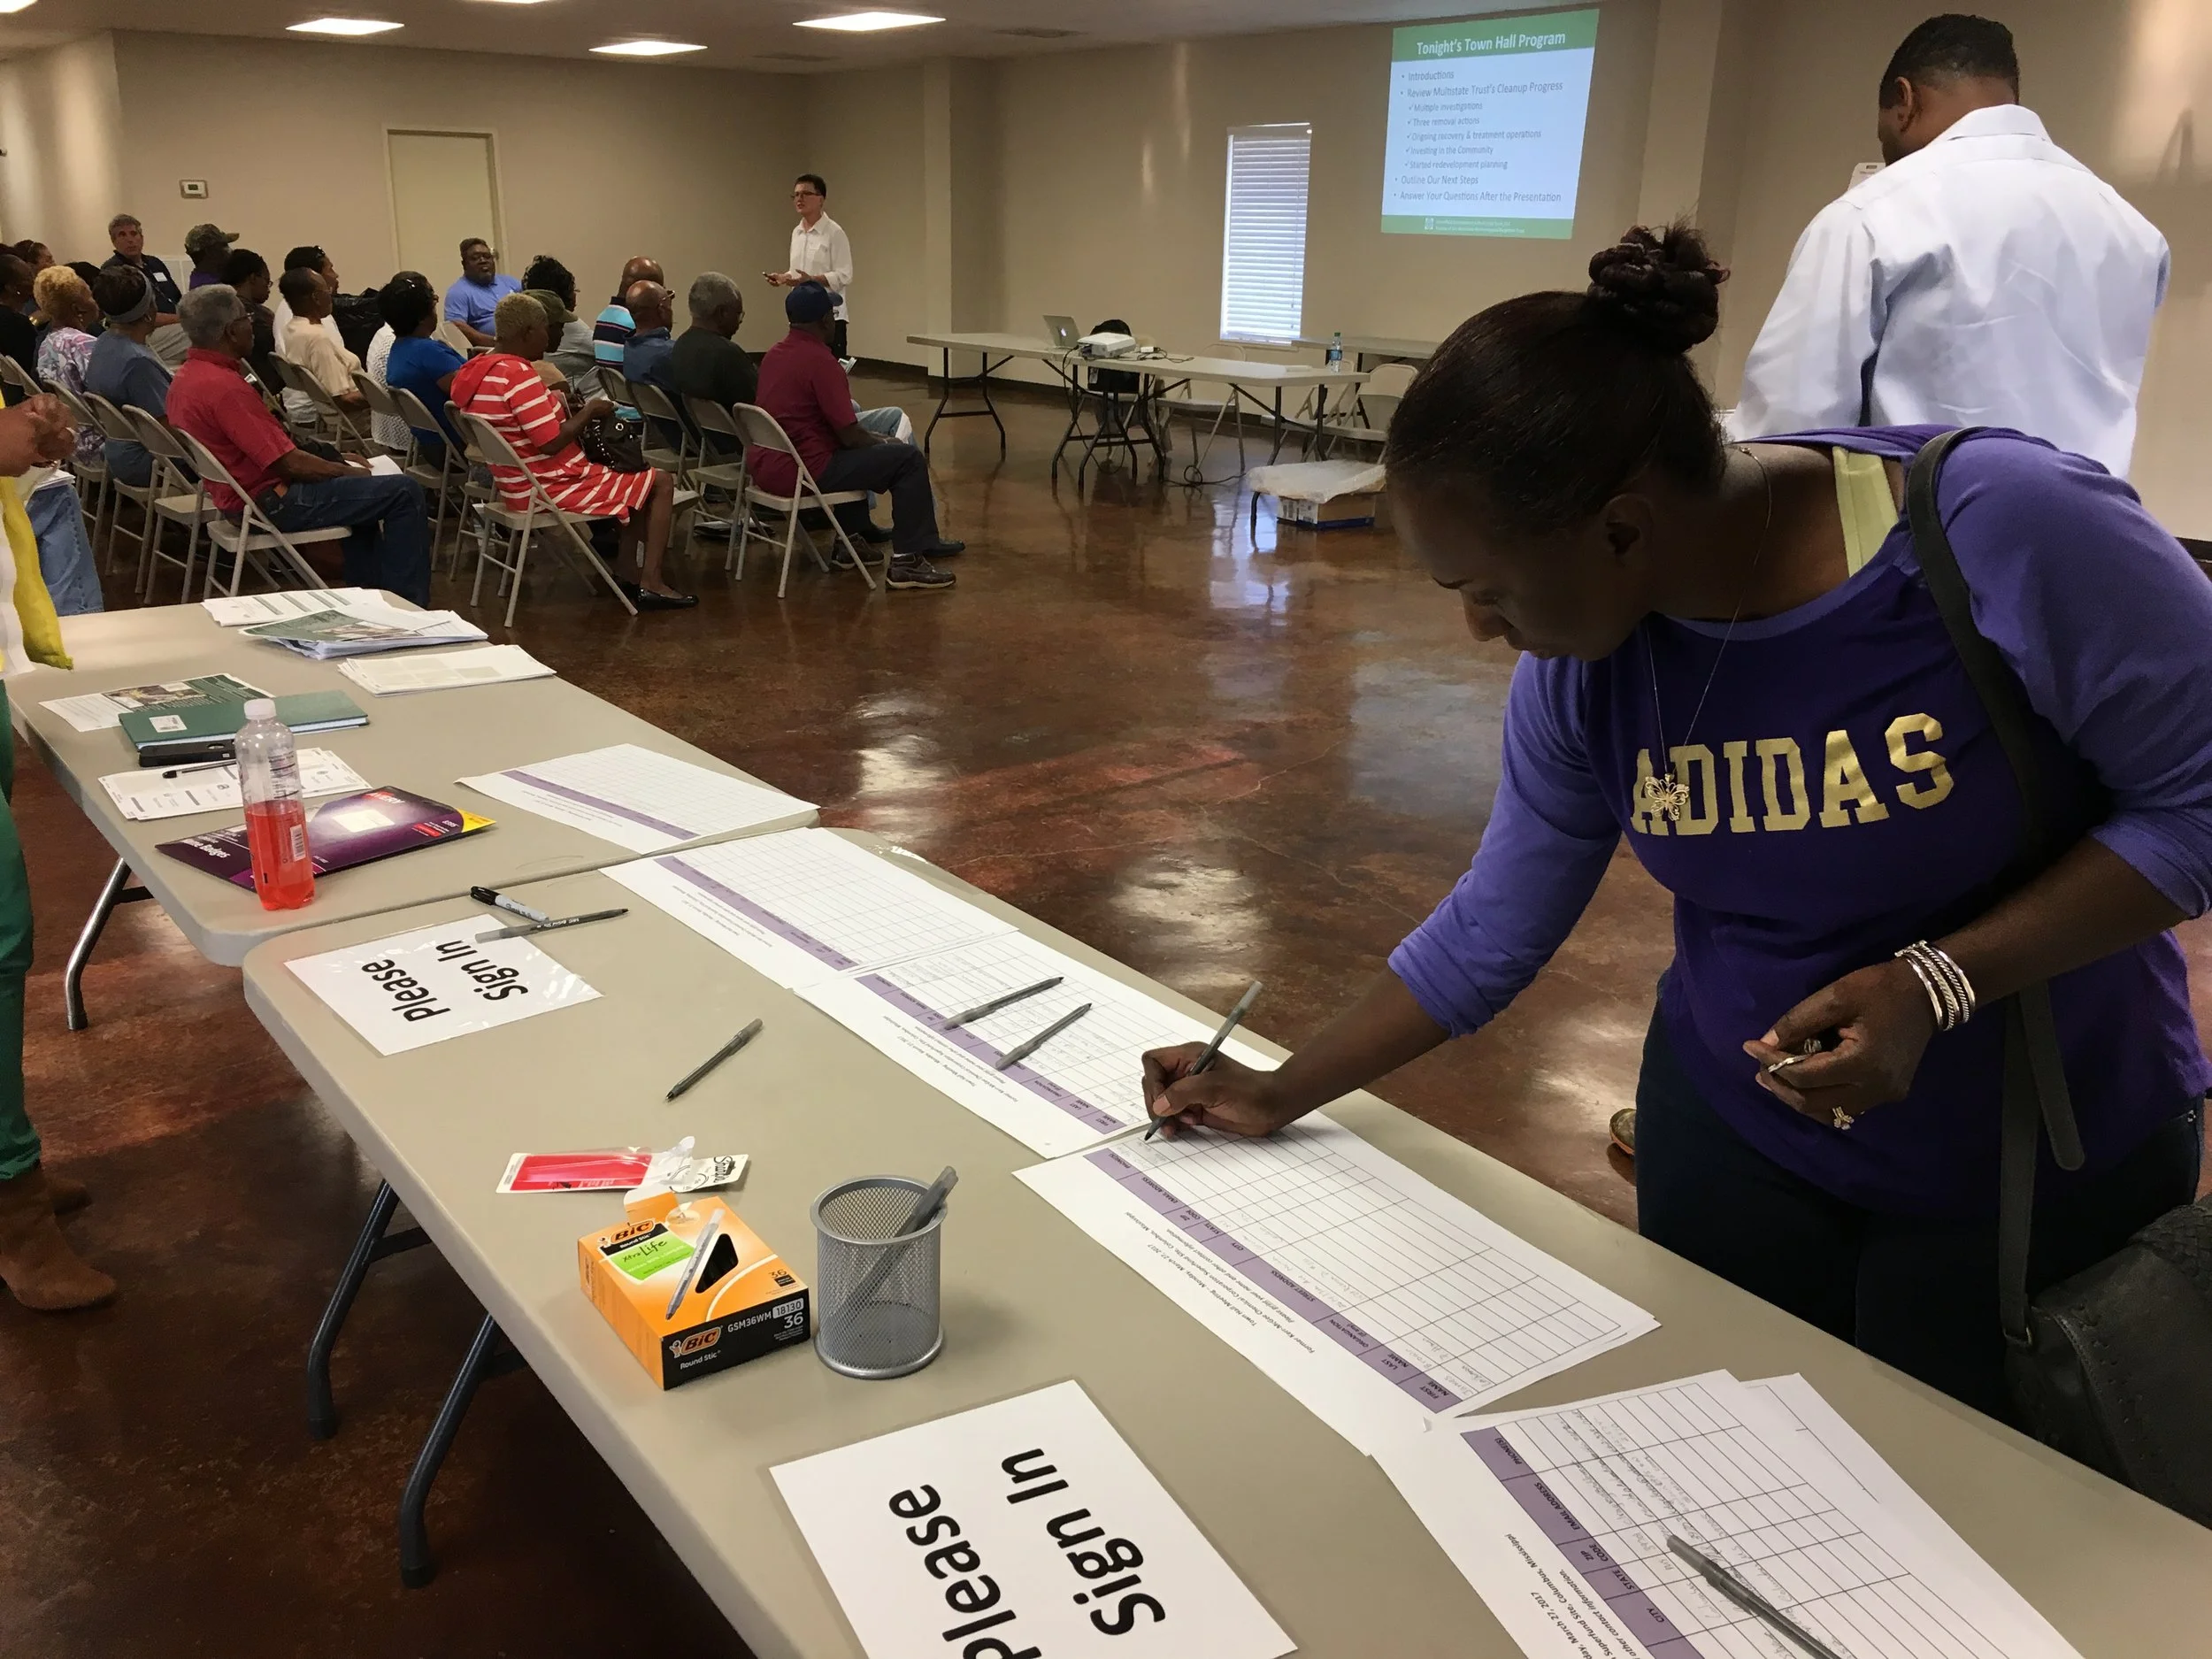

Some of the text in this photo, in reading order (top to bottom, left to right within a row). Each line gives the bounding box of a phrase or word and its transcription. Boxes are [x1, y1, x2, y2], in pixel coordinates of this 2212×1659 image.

[1417, 32, 1565, 57] Tonight's Town Hall Program
[1409, 71, 1454, 81] Introductions
[1408, 81, 1563, 97] Review Multistate Trust's Cleanup Progress
[1411, 146, 1437, 156] Investing
[1458, 146, 1493, 156] Community
[1432, 160, 1479, 170] redevelopment
[1480, 160, 1507, 170] planning
[1460, 176, 1479, 185] Steps
[1443, 191, 1478, 202] Questions
[1480, 192, 1497, 201] After
[1499, 192, 1511, 201] the
[1513, 192, 1561, 202] Presentation
[1630, 712, 1955, 835] ADIDAS
[435, 941, 528, 1001] Sign In
[361, 959, 451, 1022] Please
[1229, 1241, 1245, 1251] CITY
[1269, 1270, 1297, 1287] ADDRESS
[1293, 1286, 1317, 1302] STREET
[727, 1301, 801, 1333] GSM36WM 18130
[784, 1312, 803, 1328] 36
[680, 1352, 718, 1370] Round Stic
[1380, 1357, 1399, 1370] LAST
[1386, 1352, 1409, 1367] NAME
[1417, 1385, 1440, 1399] FIRST
[1426, 1380, 1450, 1396] NAME
[1493, 1437, 1525, 1464] PHONE(S)
[1532, 1481, 1582, 1530] EMAIL ADDRESS
[1001, 1448, 1166, 1636] Sign In
[1578, 1549, 1595, 1561] ZIP
[1587, 1543, 1609, 1562] CODE
[888, 1484, 1042, 1659] Please
[1611, 1569, 1635, 1589] STATE
[1502, 1532, 1615, 1656] Superfund Site, Columbus, Mississippi
[1529, 1590, 1551, 1609] 2017
[1544, 1608, 1561, 1620] 27,
[1555, 1568, 1638, 1657] other contact information.
[1646, 1607, 1665, 1623] CITY
[1553, 1620, 1580, 1644] March
